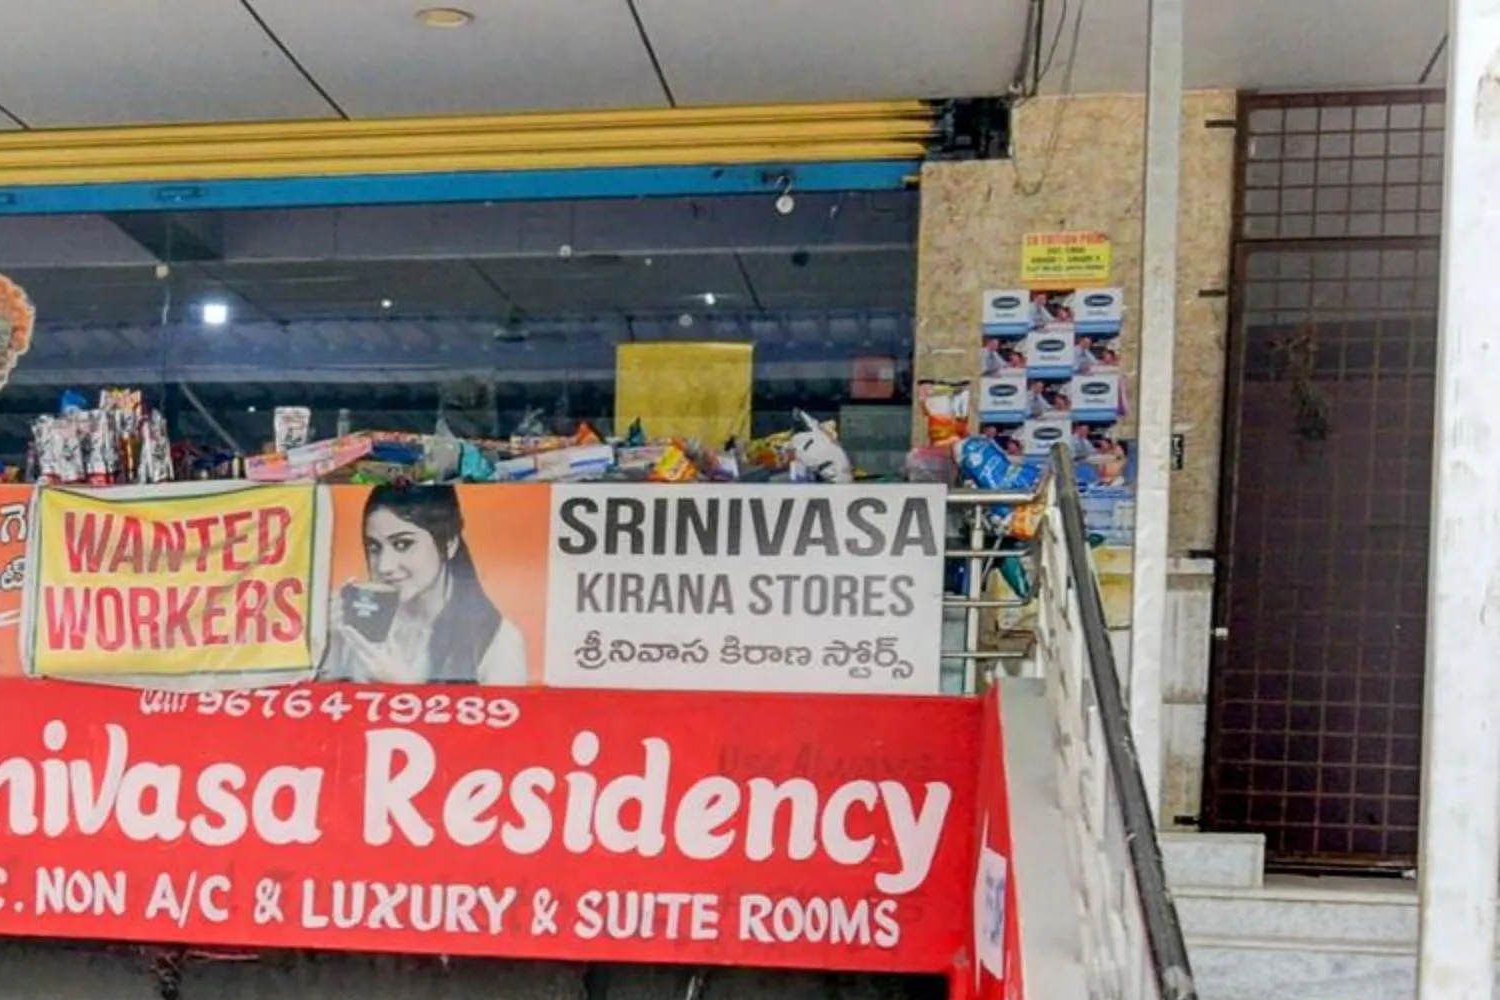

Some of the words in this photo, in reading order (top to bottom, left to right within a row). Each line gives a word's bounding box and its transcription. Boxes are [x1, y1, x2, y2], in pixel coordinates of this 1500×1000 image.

[63, 505, 293, 574] WANTED
[557, 495, 938, 557] SRINIVASA
[44, 576, 304, 652] WORKERS
[576, 571, 736, 617] KIRANA
[748, 573, 915, 618] STORES
[196, 689, 520, 728] 9676479289
[361, 727, 953, 895] Residency
[36, 866, 126, 916] NON
[145, 871, 230, 928] A/C
[254, 875, 284, 925] &
[302, 878, 517, 935] LUXURY
[530, 888, 559, 935] &
[575, 891, 718, 942] SUITE
[739, 894, 901, 949] ROOMS
